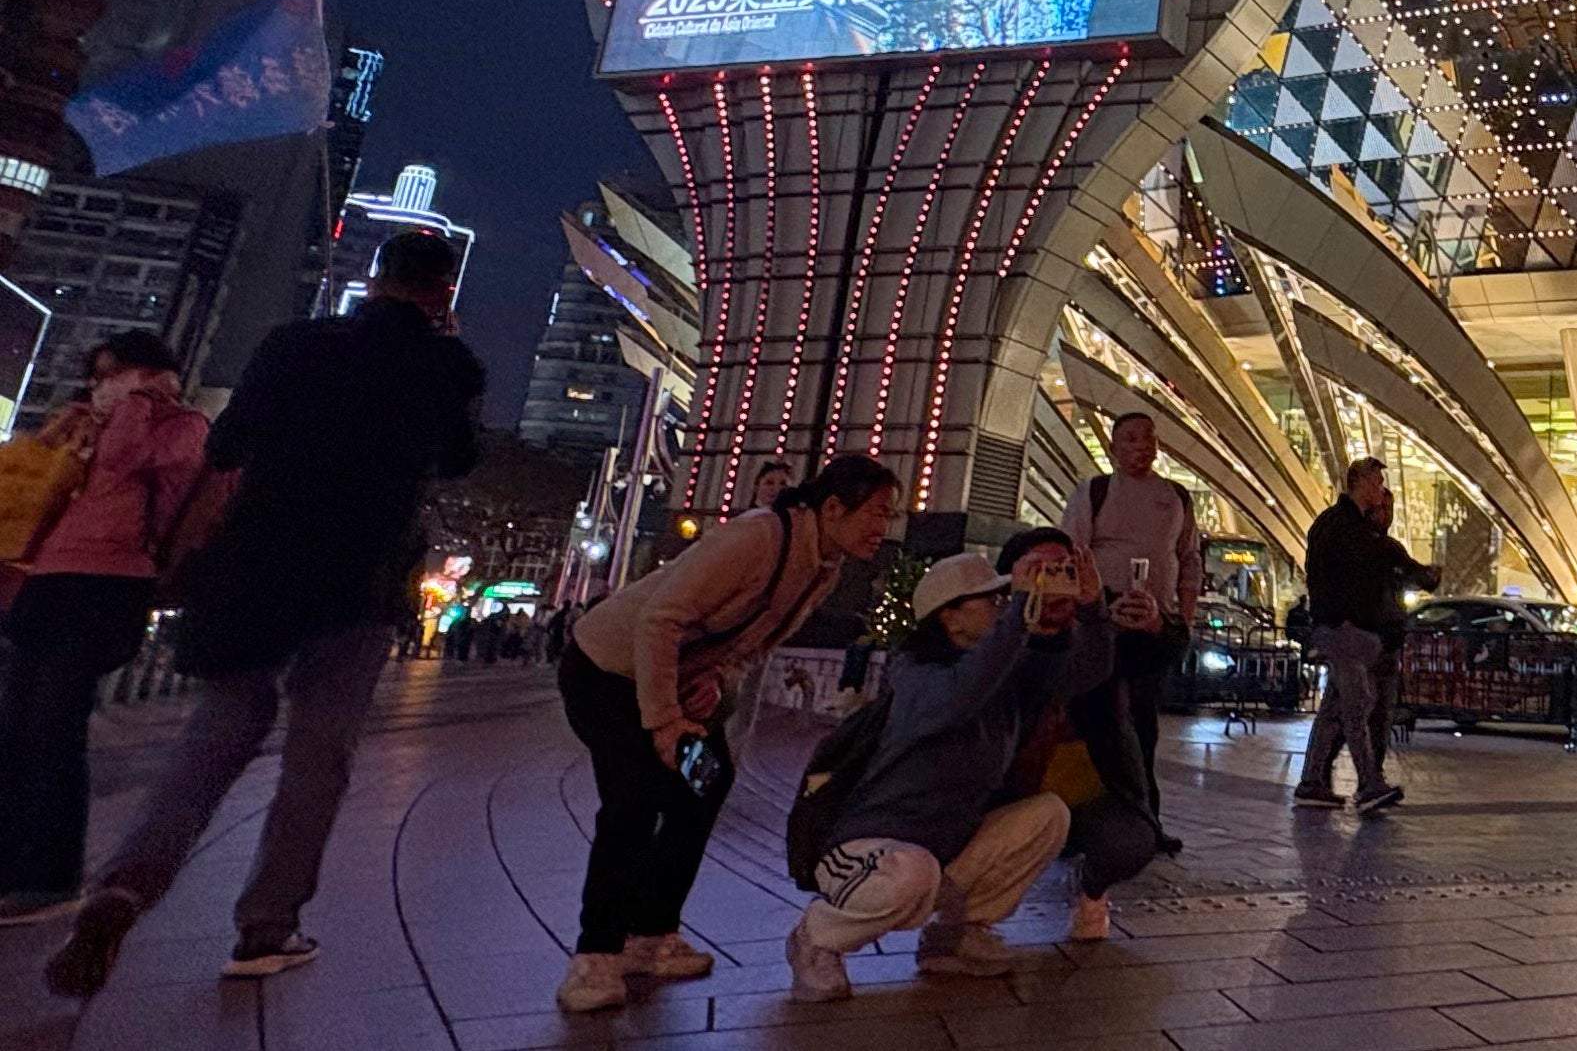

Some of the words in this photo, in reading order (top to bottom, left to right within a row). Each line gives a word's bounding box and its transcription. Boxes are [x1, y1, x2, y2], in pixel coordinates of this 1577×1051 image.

[644, 22, 676, 39] Cidade
[676, 19, 709, 36] Cultural
[742, 13, 777, 31] Oriental
